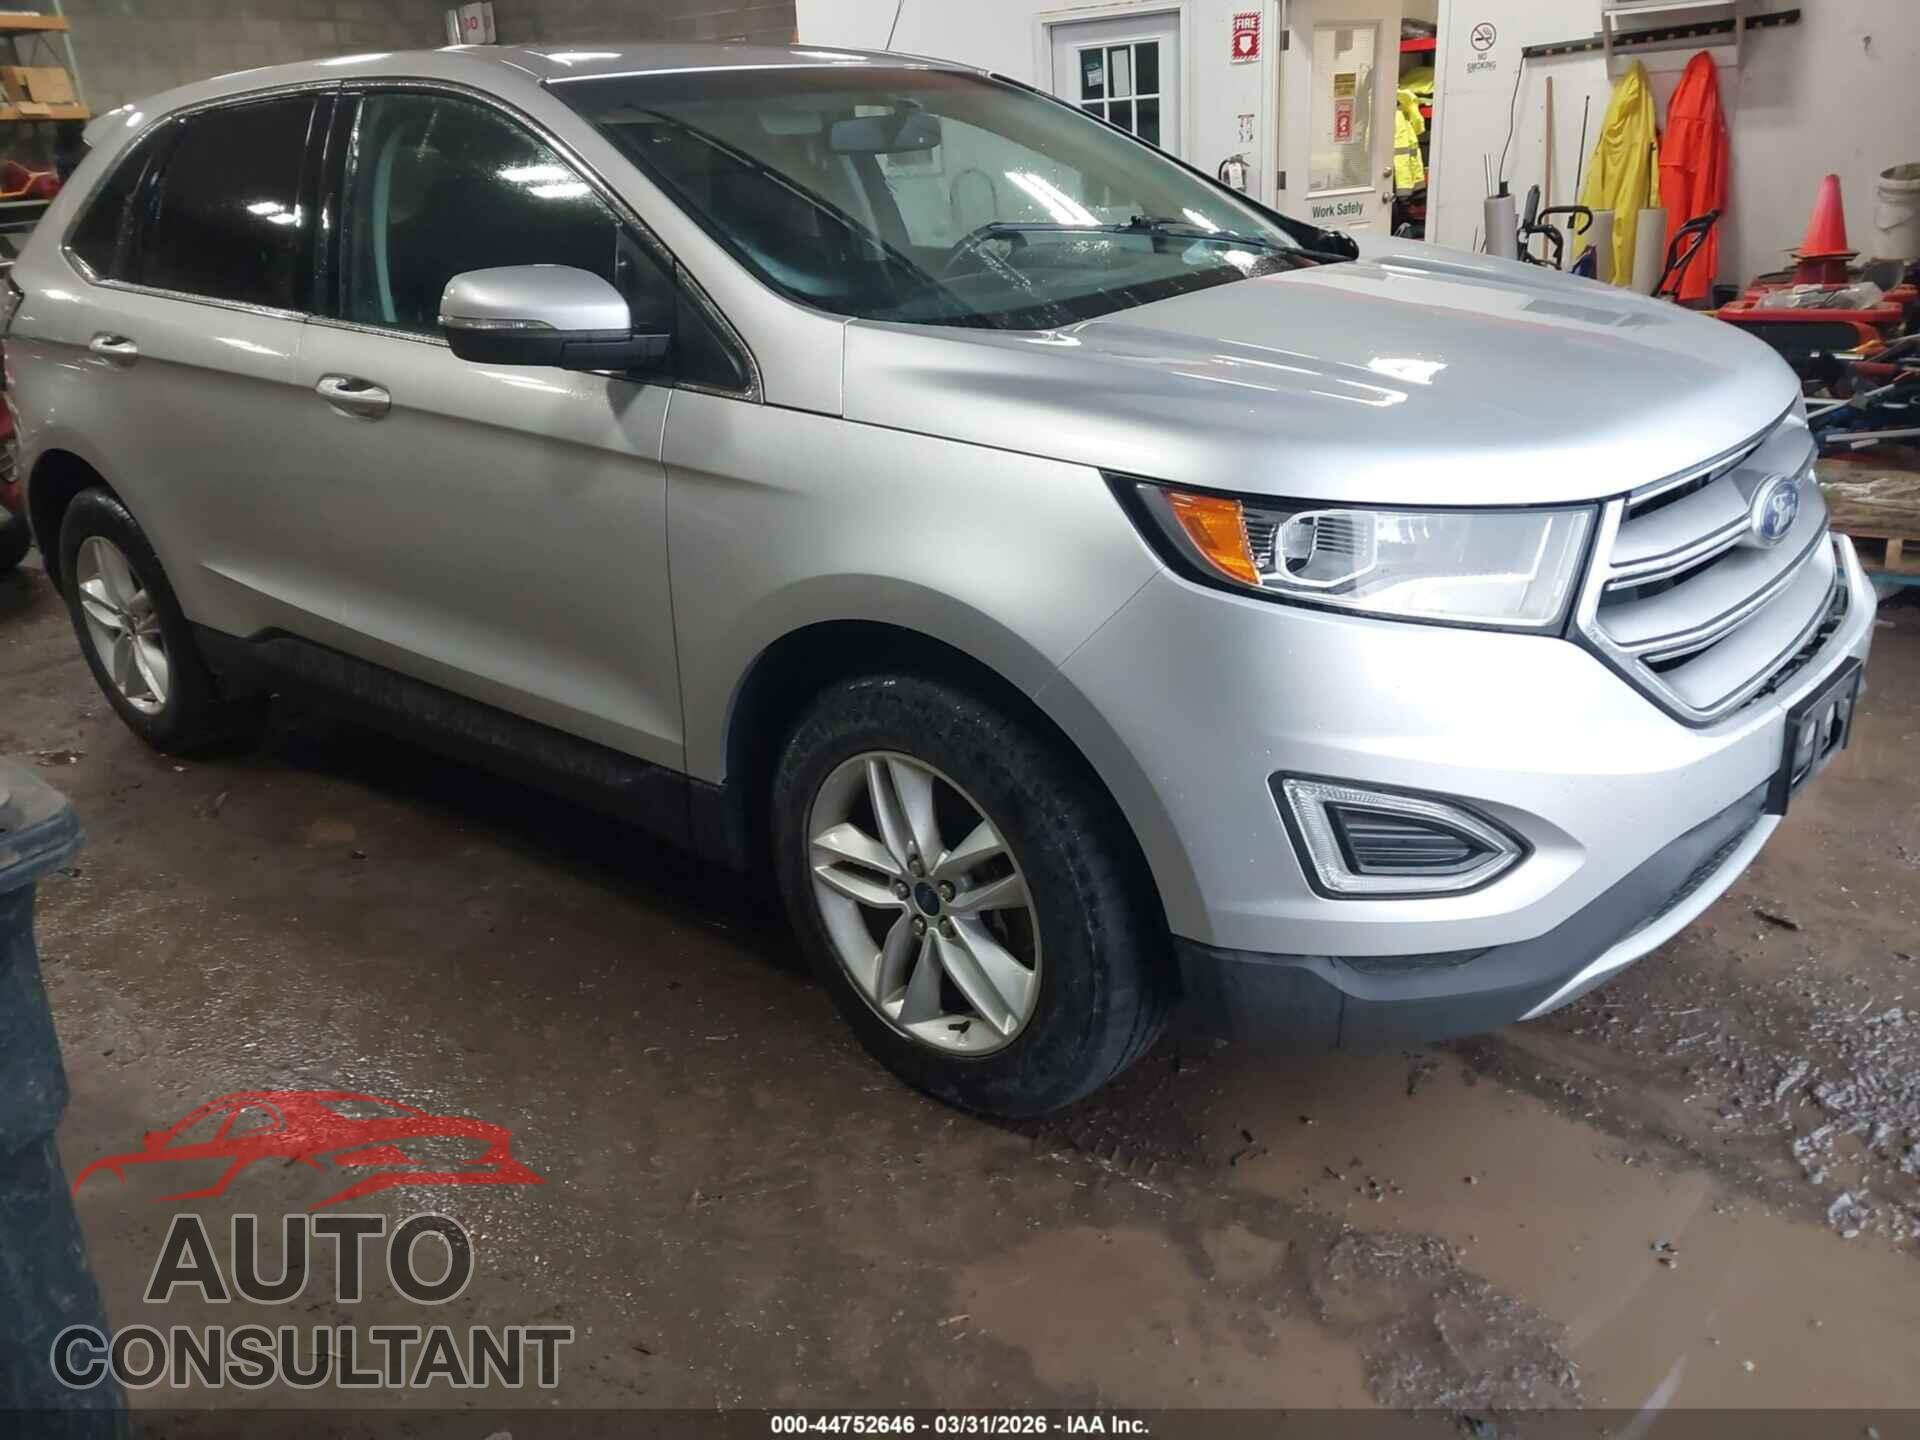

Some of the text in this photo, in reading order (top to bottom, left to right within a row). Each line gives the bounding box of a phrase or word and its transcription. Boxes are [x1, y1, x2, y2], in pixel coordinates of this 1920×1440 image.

[1236, 17, 1257, 30] FIRE
[1312, 201, 1363, 219] Work Safely
